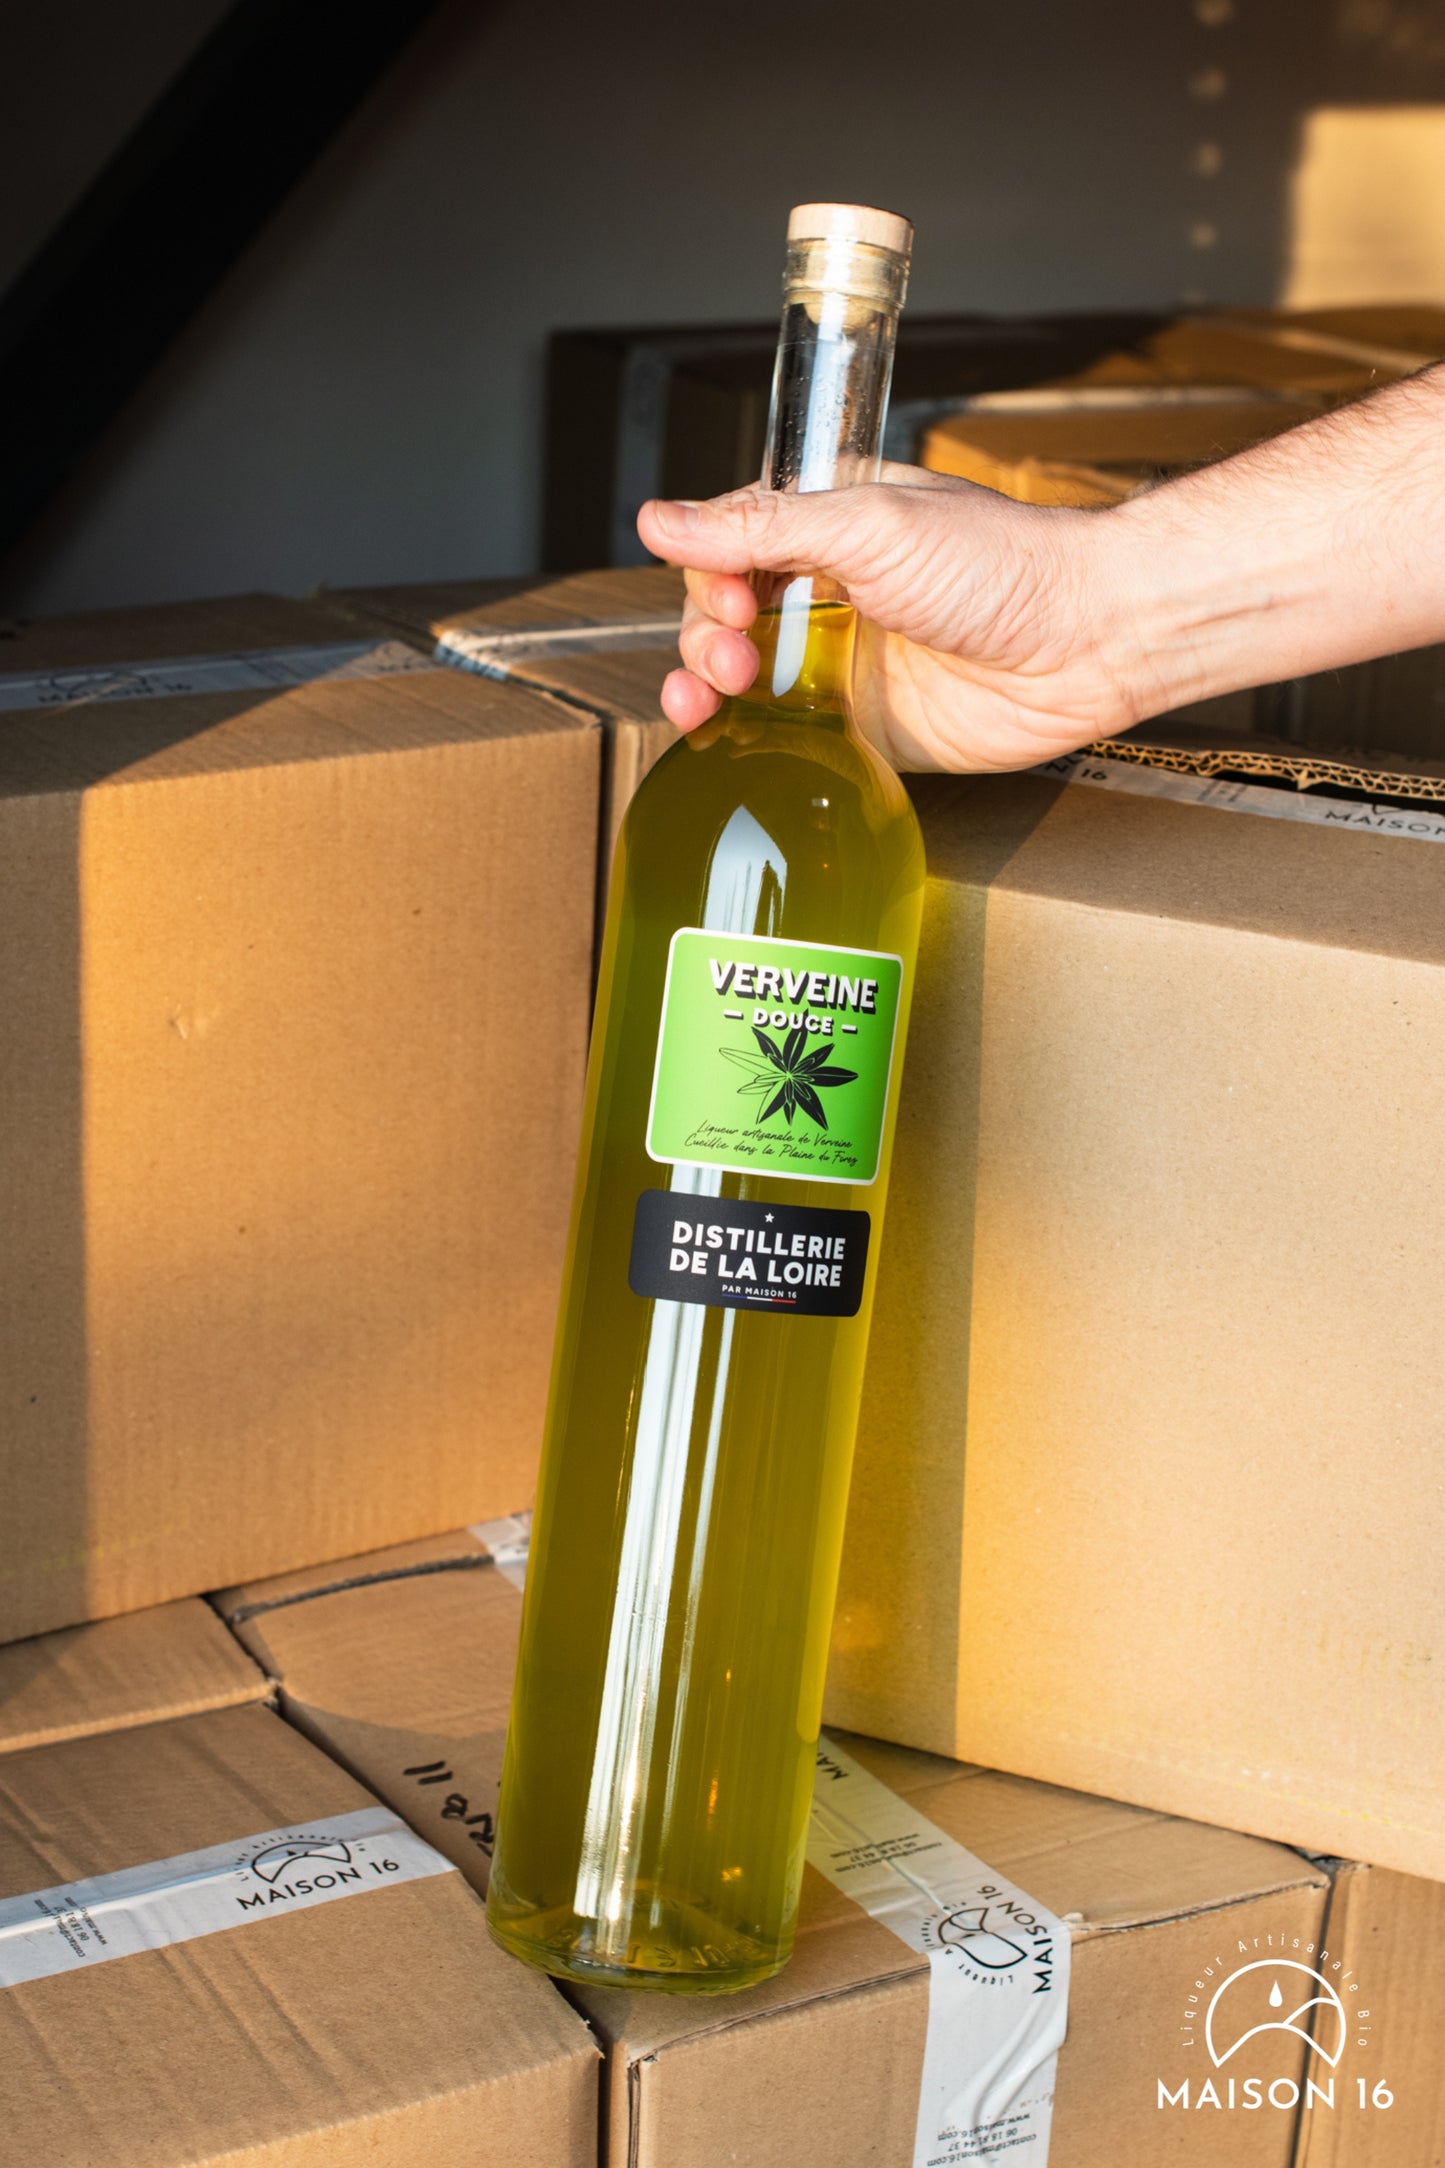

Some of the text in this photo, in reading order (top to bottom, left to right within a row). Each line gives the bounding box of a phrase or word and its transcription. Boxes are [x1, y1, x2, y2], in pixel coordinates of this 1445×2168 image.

[709, 958, 878, 1013] VERVEINE
[753, 1007, 834, 1035] DOUCE
[696, 1119, 853, 1149] Liqueur artisanale de Verveine
[733, 1140, 758, 1156] dans
[762, 1143, 775, 1156] la
[778, 1143, 815, 1160] Plaine
[818, 1149, 830, 1162] du
[672, 1220, 846, 1260] DISTILLERIE
[669, 1248, 842, 1287] DE LA LOIRE
[721, 1284, 797, 1299] PAR MAISON 16
[236, 1866, 362, 1911] MAISON
[369, 1859, 400, 1875] 16
[977, 1885, 1053, 1994] MAISON 16
[1006, 2127, 1018, 2137] 06
